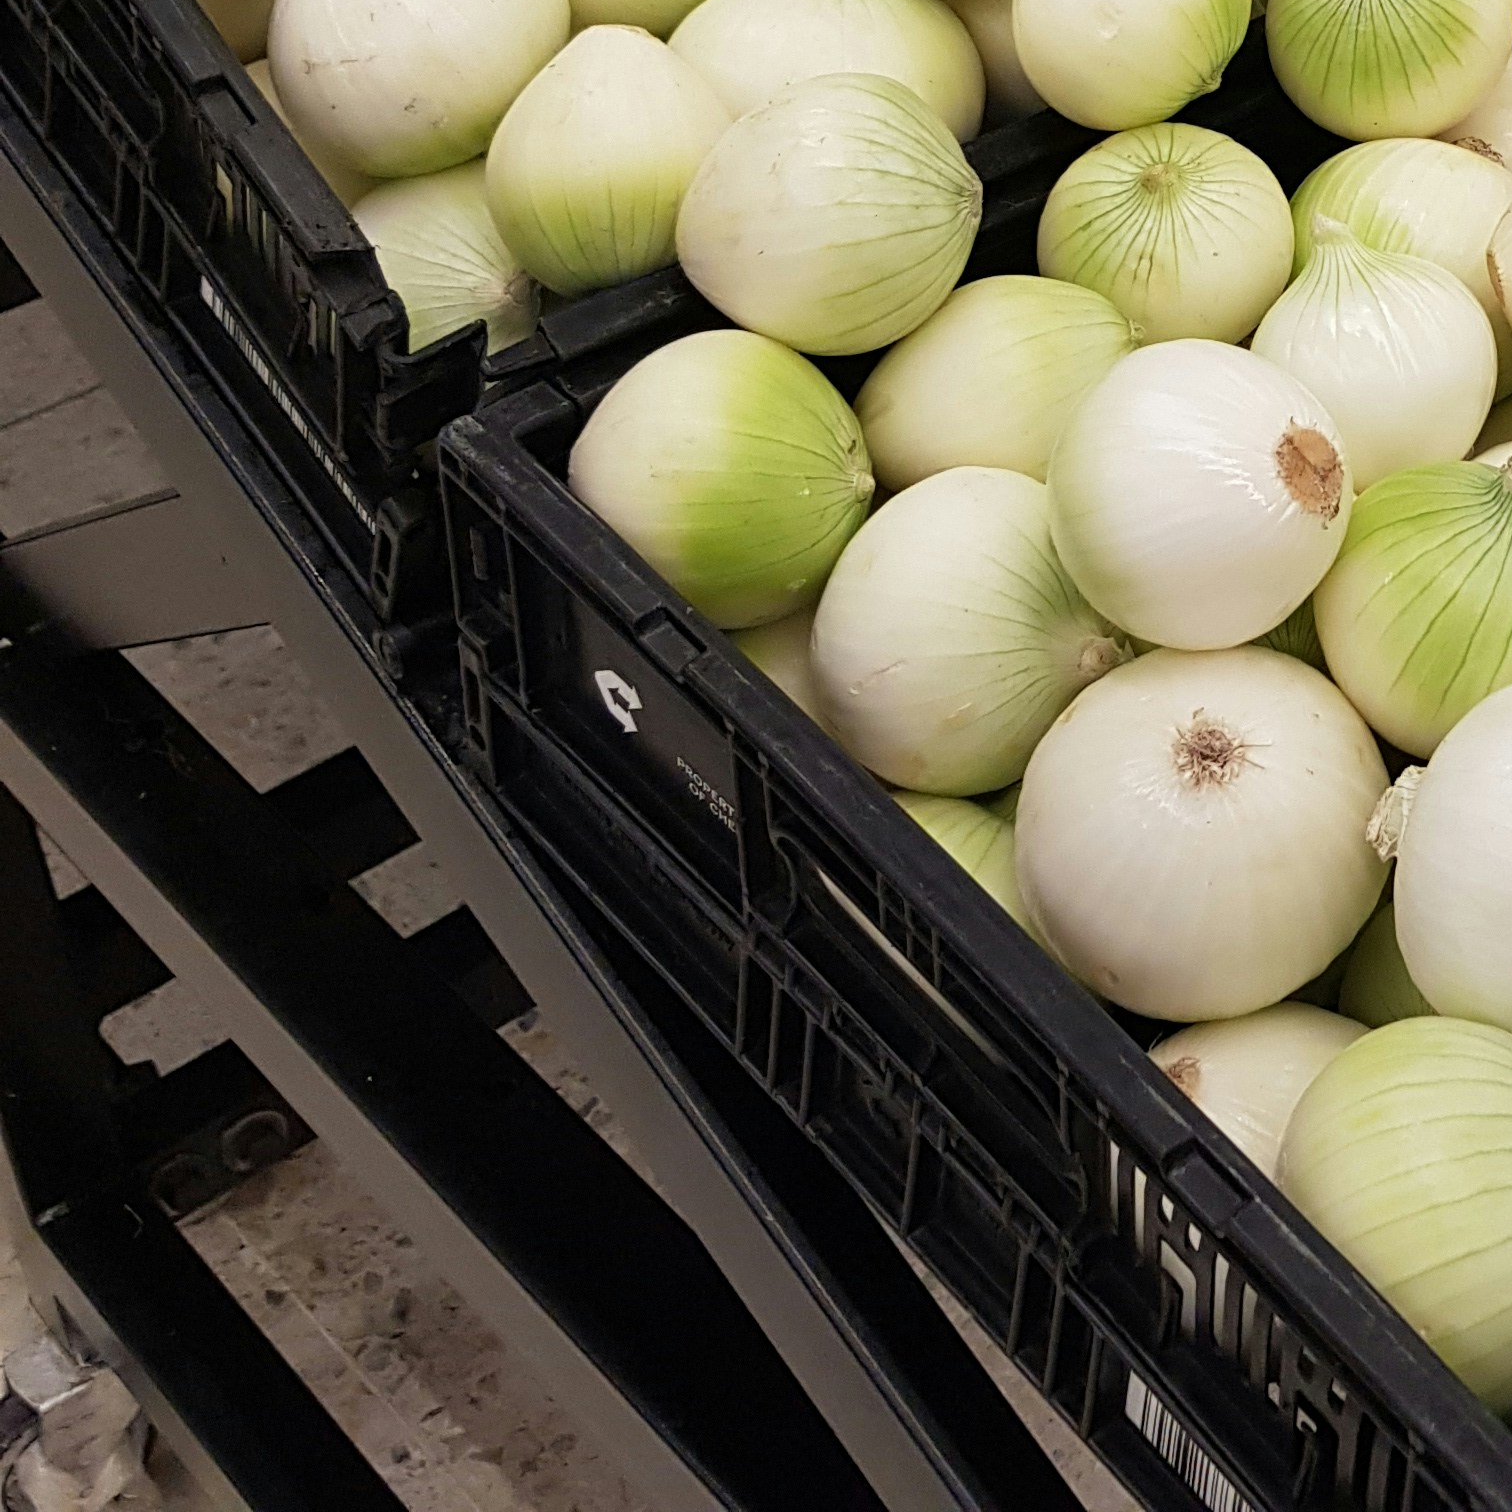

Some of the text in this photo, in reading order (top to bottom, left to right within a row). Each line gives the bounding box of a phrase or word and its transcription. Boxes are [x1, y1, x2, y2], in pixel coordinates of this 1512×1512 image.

[676, 756, 735, 817] PROPERT
[689, 782, 737, 833] OF CHE
